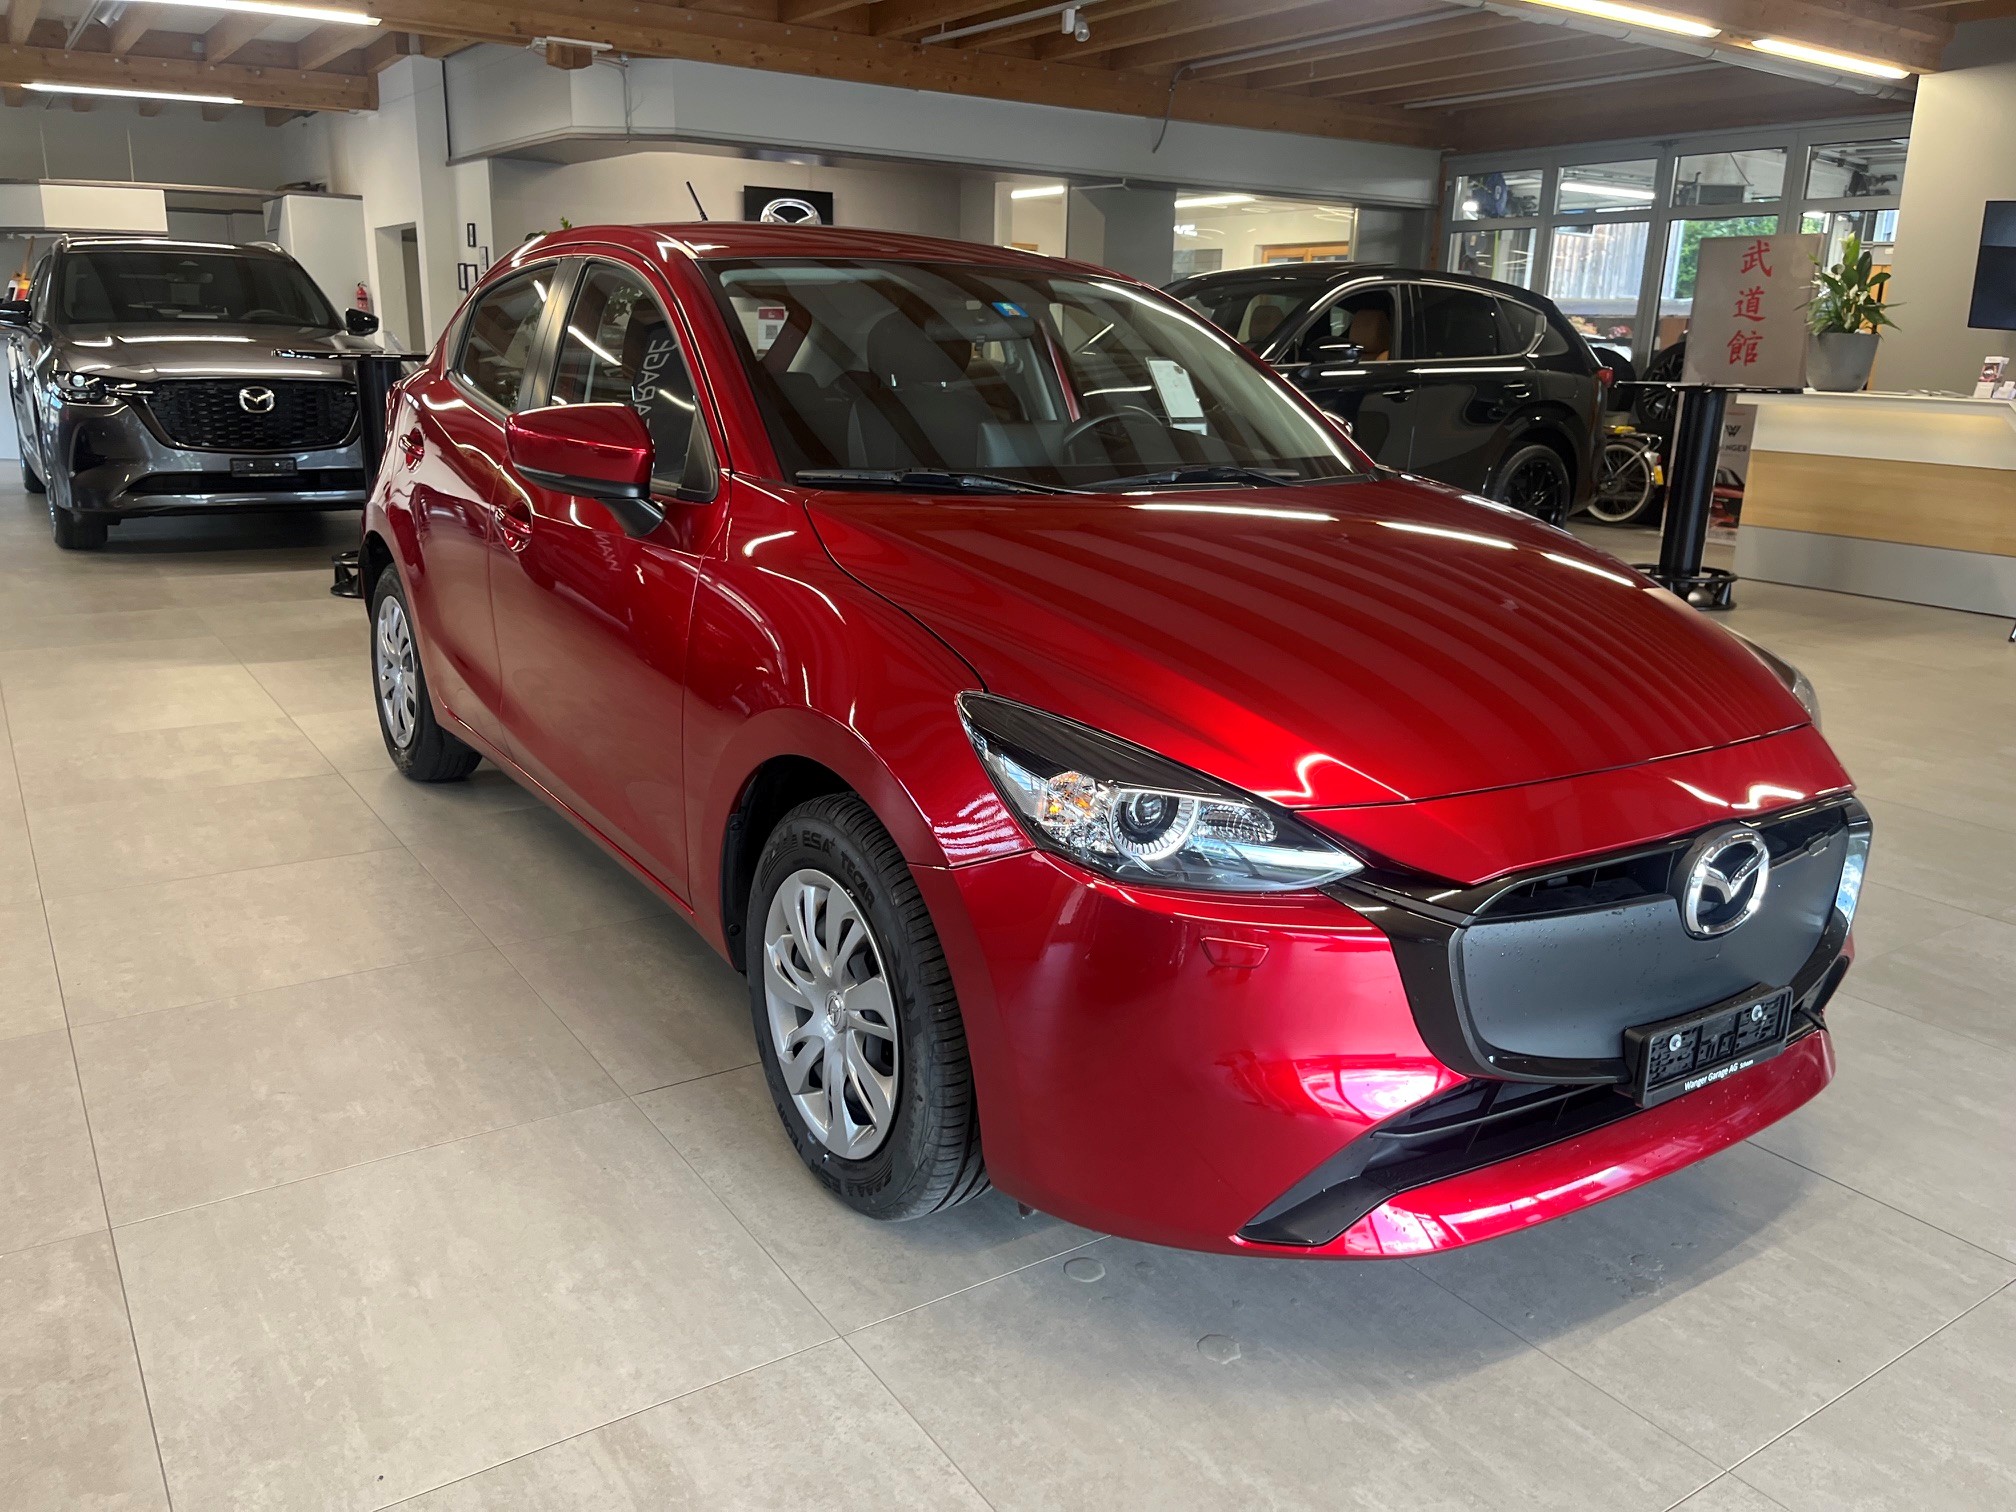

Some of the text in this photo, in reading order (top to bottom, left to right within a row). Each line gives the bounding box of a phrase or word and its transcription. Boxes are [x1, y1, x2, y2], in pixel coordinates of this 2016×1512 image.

[1726, 239, 1773, 366] 武道館
[840, 850, 876, 909] TECAR
[1685, 1076, 1707, 1090] Wanger
[1708, 1068, 1728, 1081] Garage
[1729, 1063, 1738, 1073] AG
